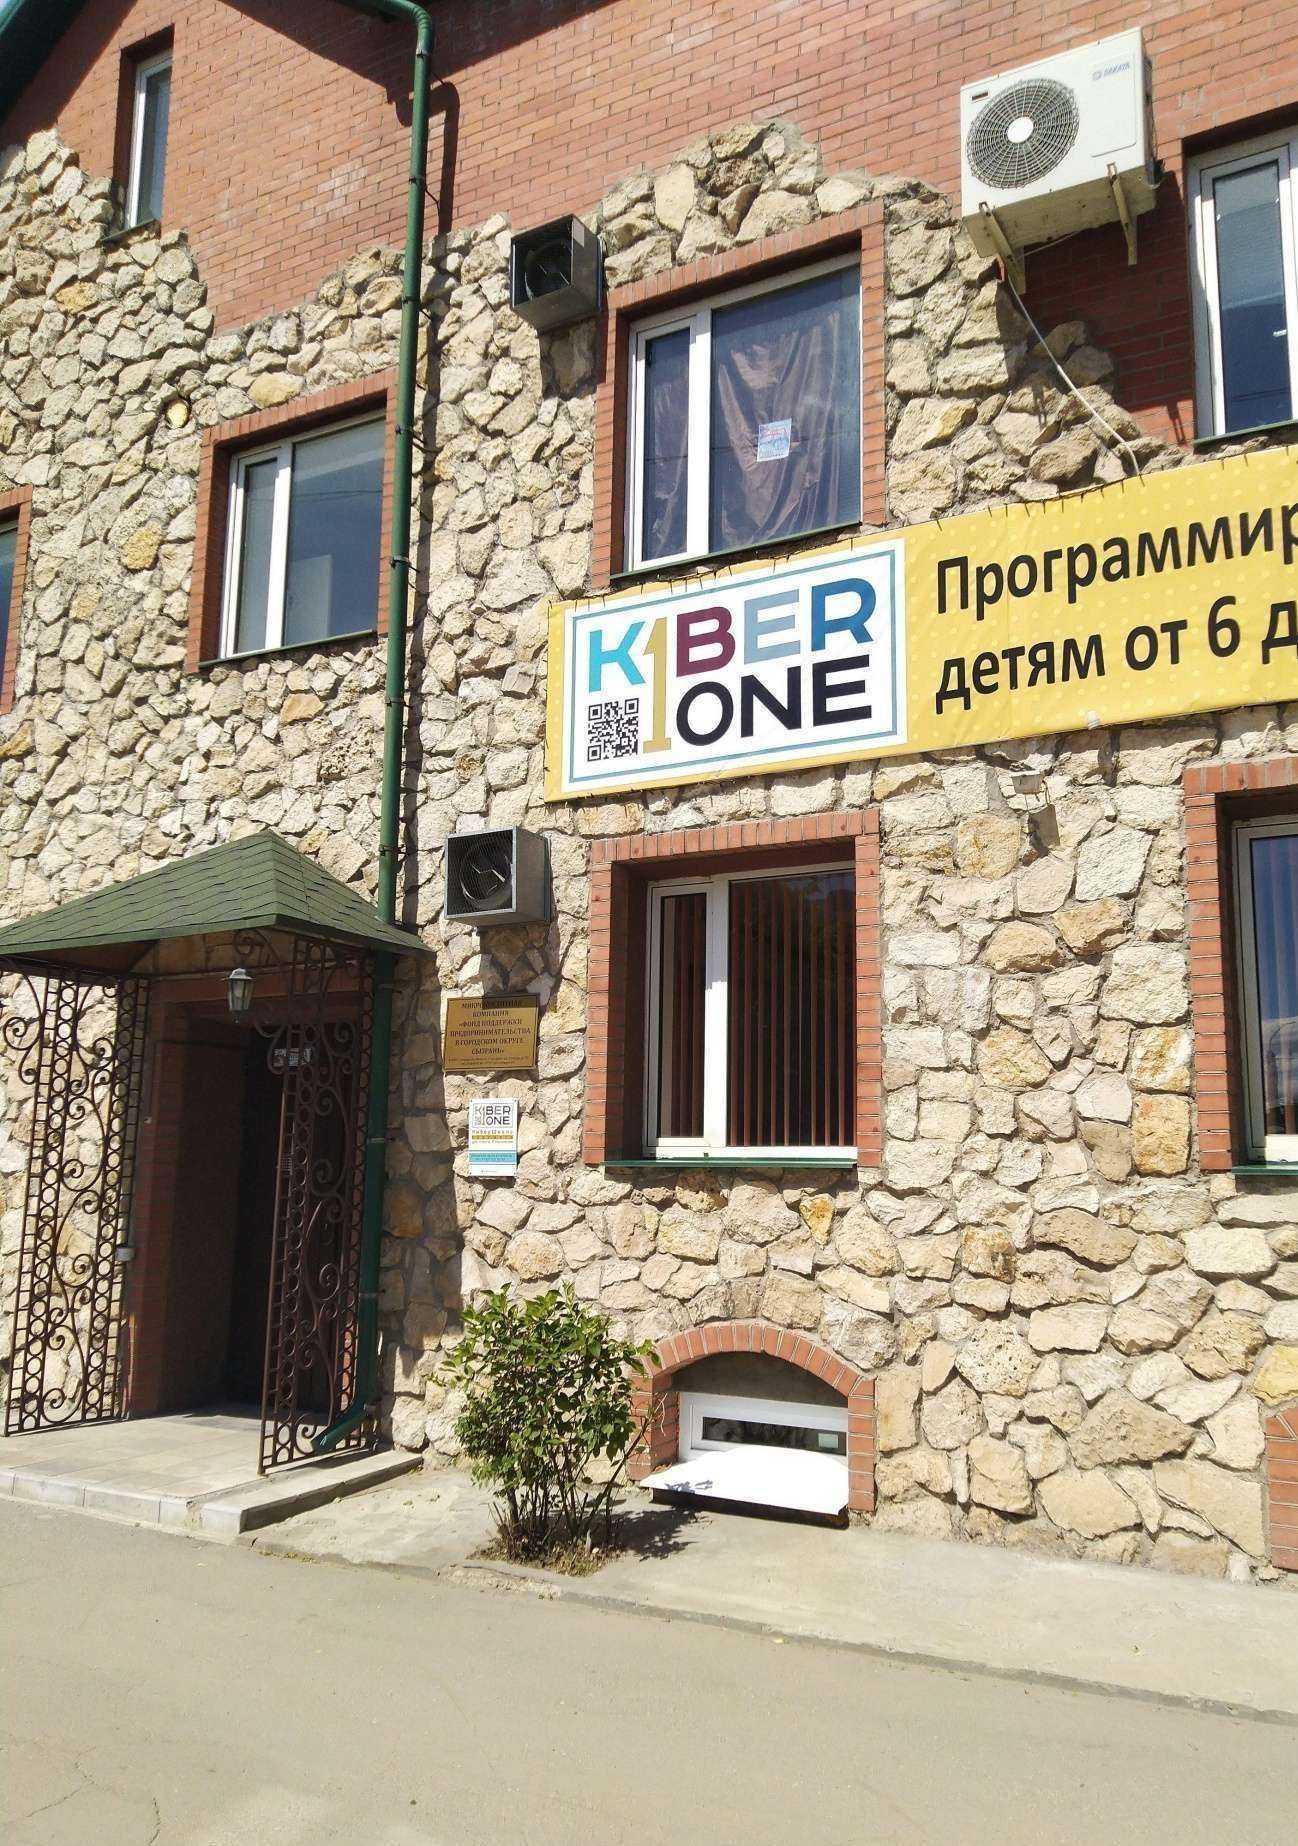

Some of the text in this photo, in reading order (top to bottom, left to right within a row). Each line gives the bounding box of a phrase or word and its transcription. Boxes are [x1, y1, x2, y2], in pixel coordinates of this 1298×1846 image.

[676, 654, 872, 747] ONE
[936, 634, 1106, 715] детям
[1125, 619, 1188, 671] от
[1207, 596, 1241, 658] 6
[486, 1116, 511, 1125] ONE
